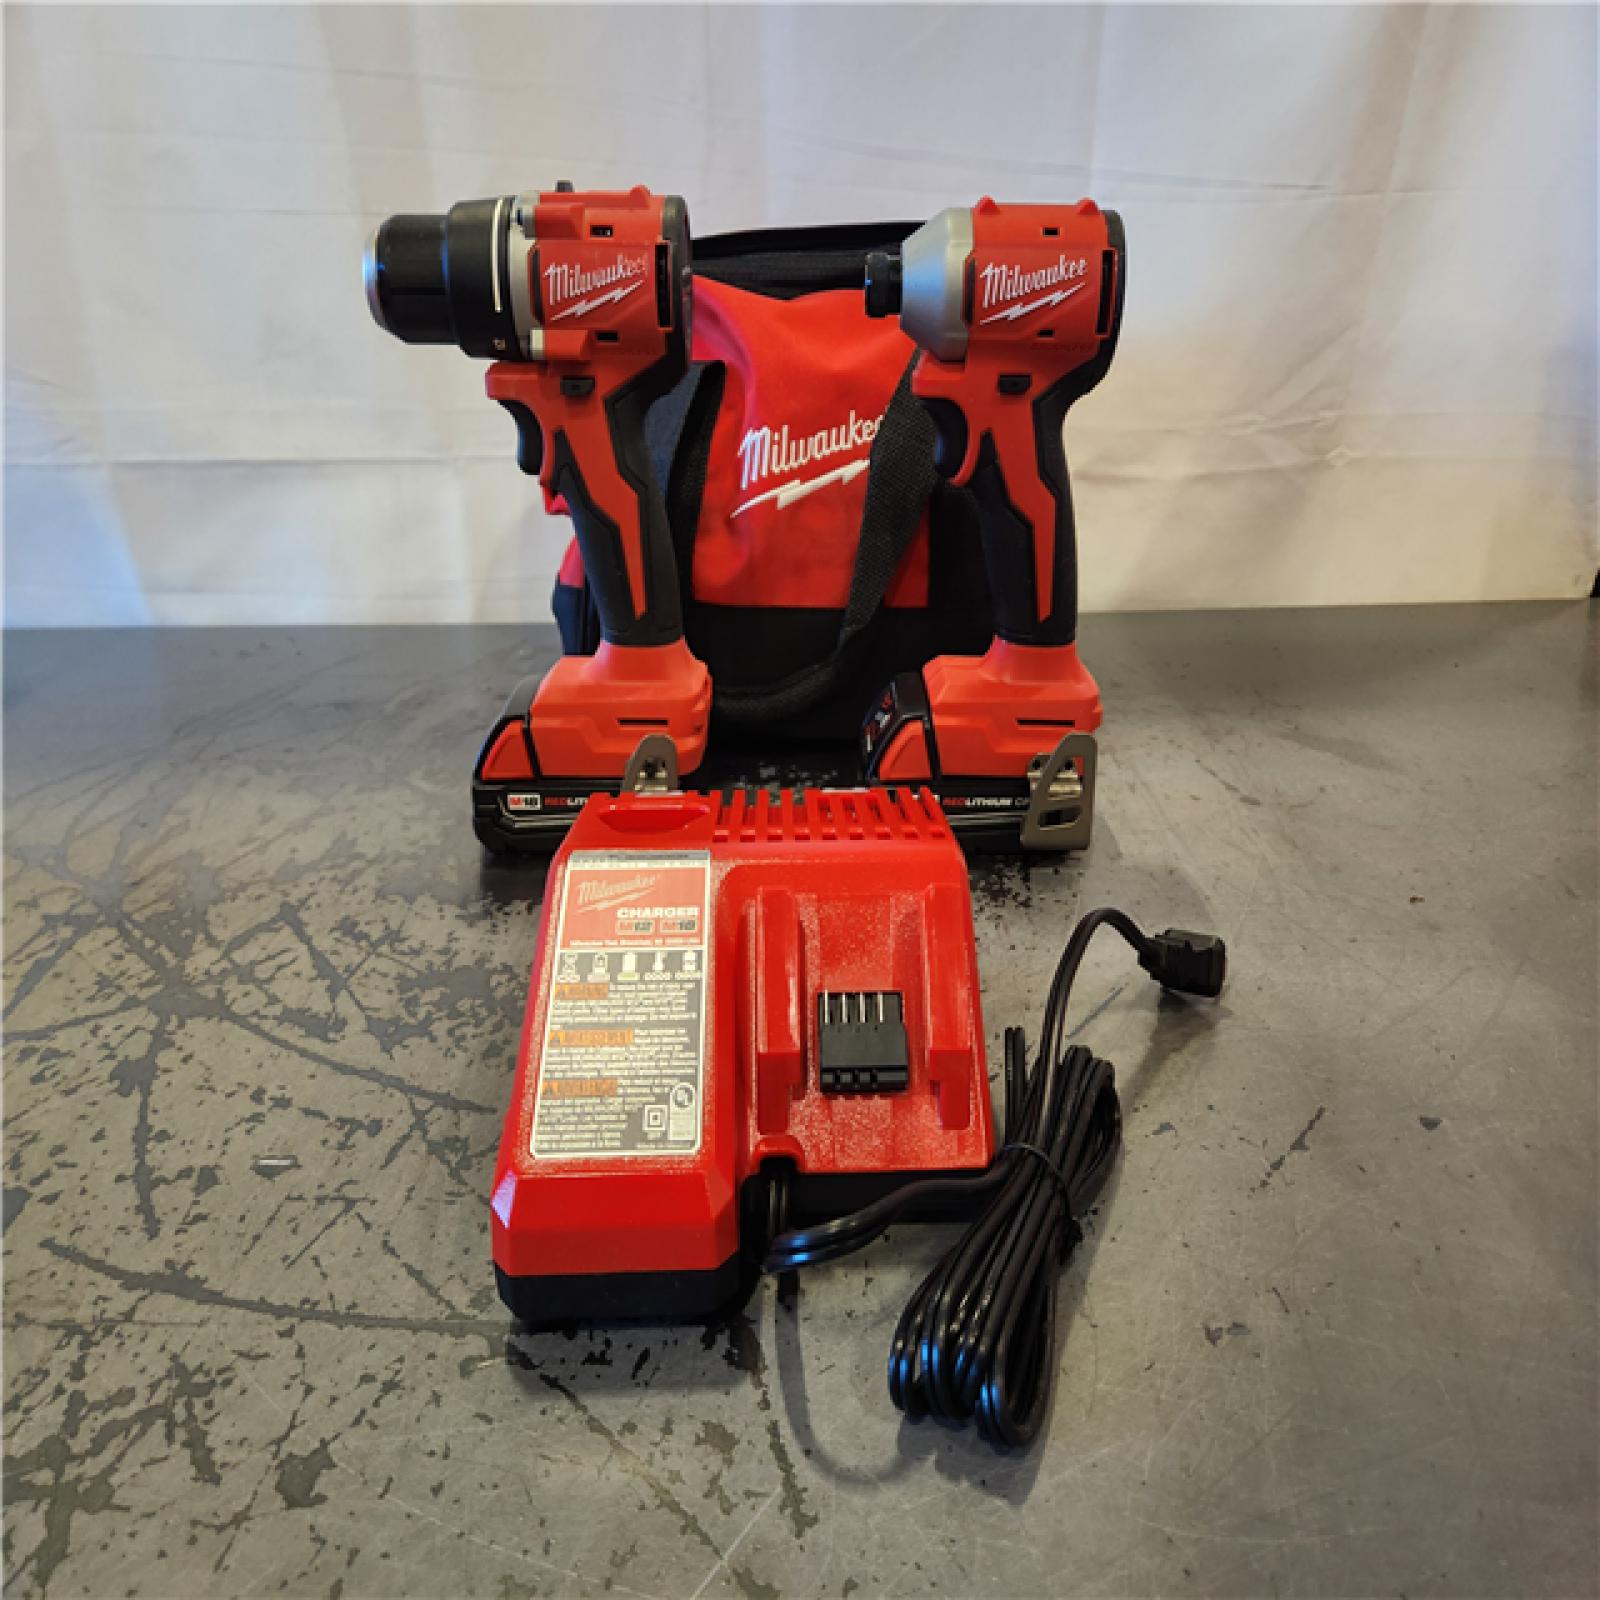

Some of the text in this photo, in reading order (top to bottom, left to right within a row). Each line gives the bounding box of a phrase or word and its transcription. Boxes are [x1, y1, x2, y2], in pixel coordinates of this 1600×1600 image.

[543, 253, 647, 306] Milwaukee
[980, 253, 1088, 309] Milwaukee
[577, 874, 657, 905] Milwaukee
[617, 906, 699, 919] CHARGER
